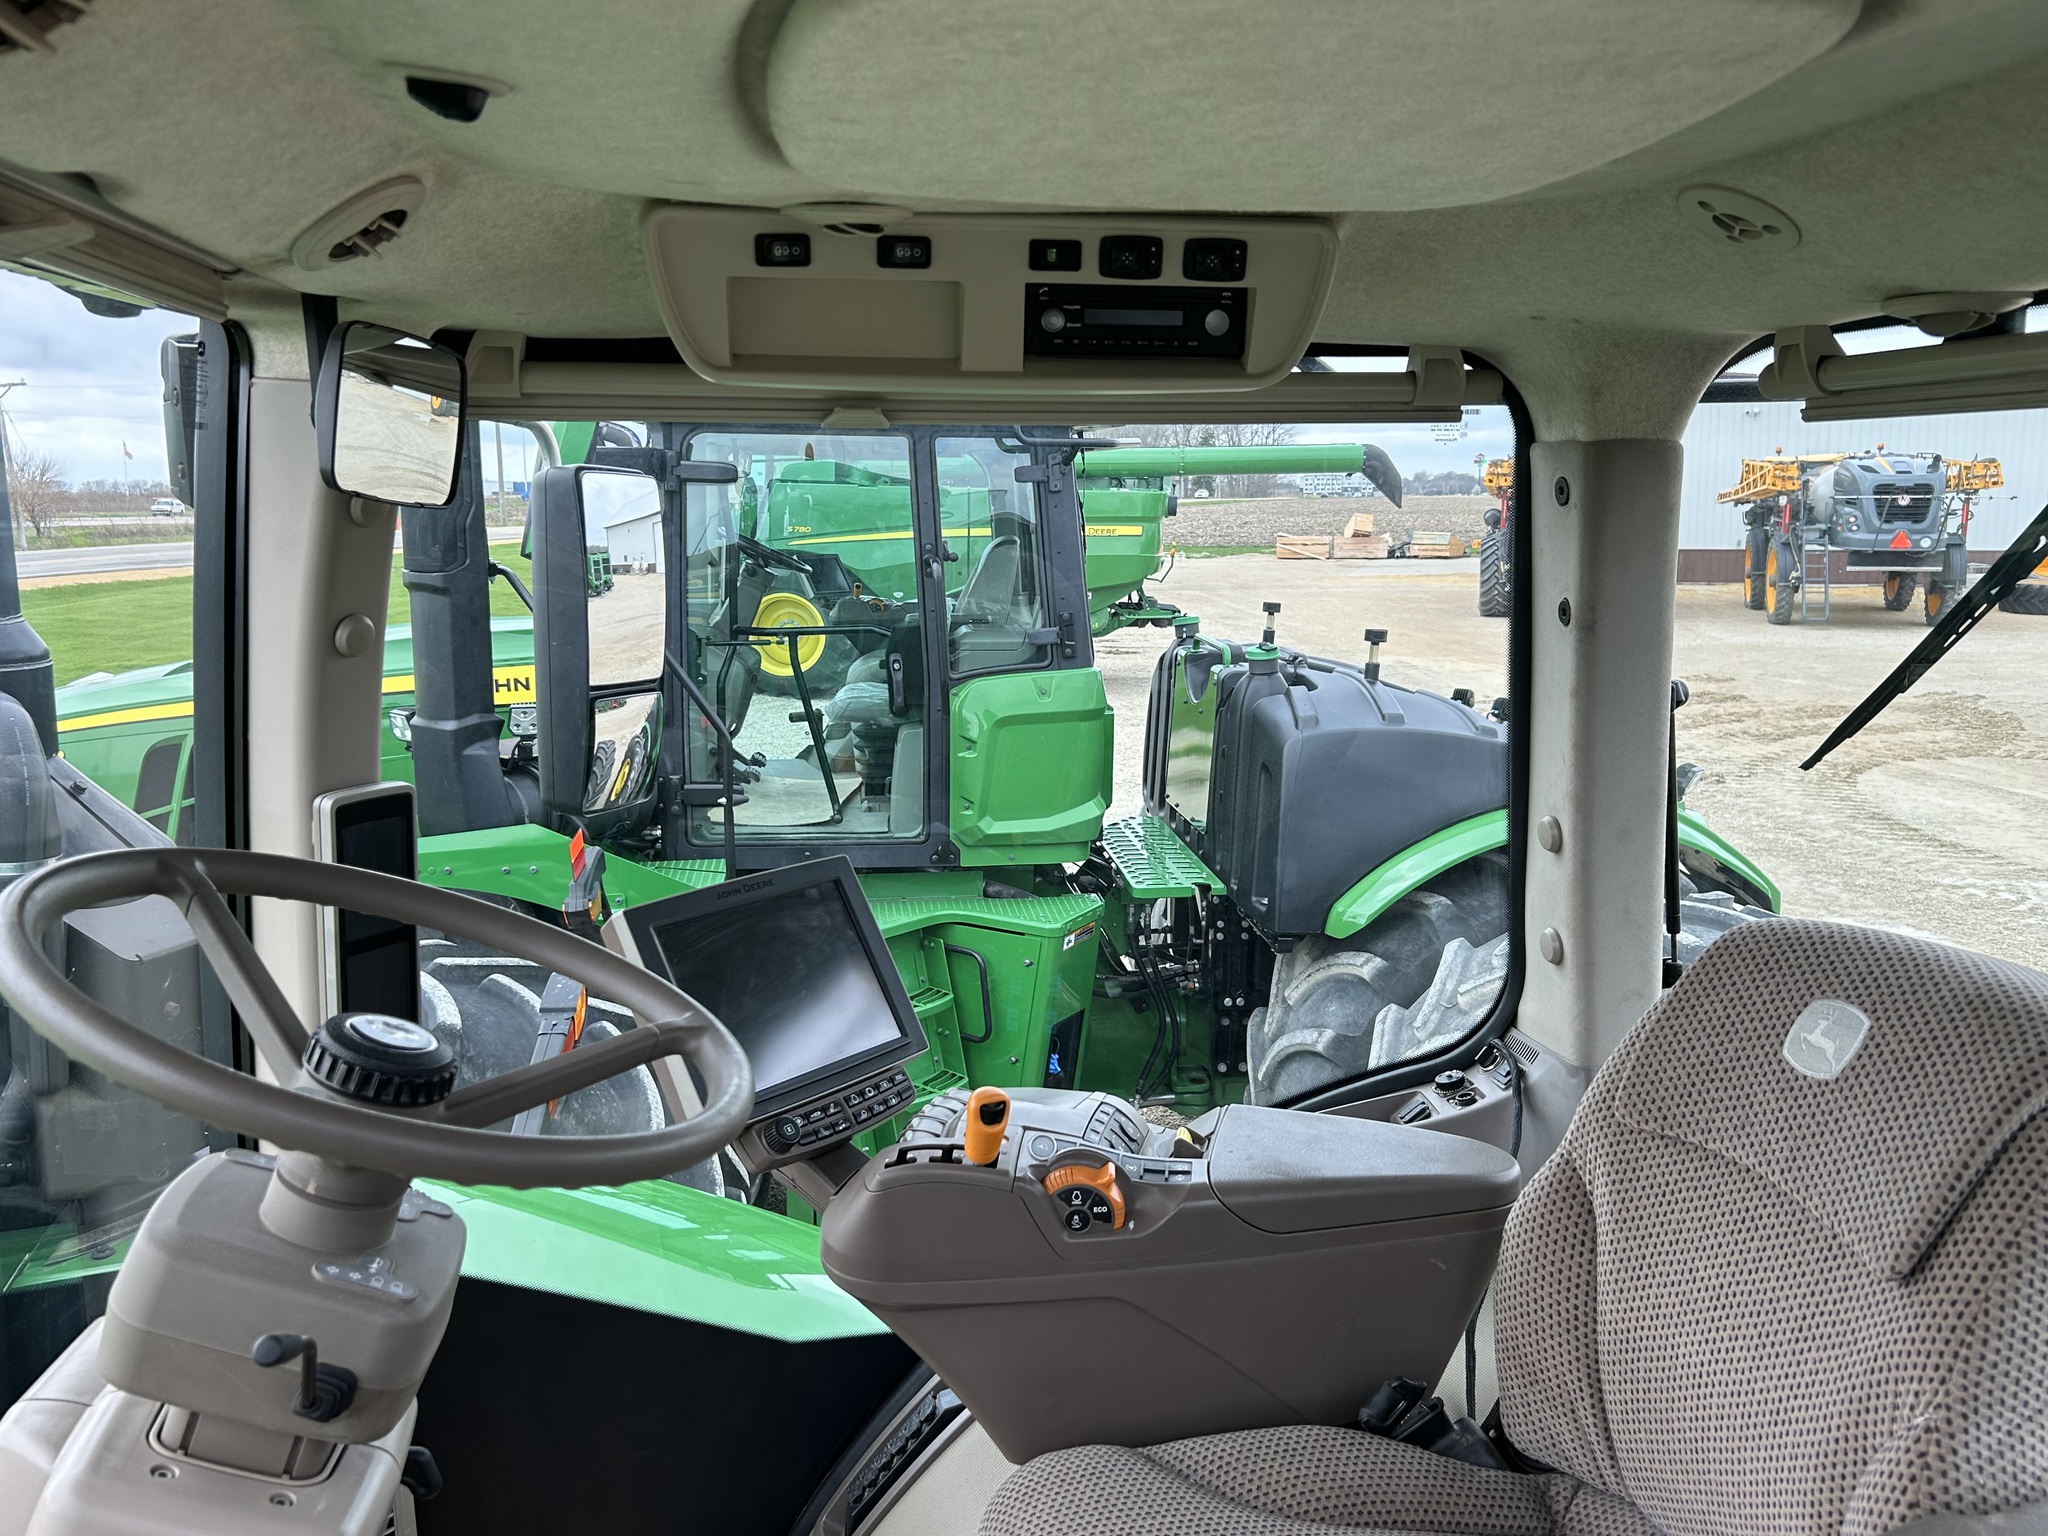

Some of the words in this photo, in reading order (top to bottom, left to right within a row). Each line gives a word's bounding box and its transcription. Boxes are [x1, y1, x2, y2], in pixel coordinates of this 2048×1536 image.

[1088, 527, 1118, 535] DEERE
[494, 676, 531, 693] HN
[716, 887, 742, 901] JOHN
[742, 878, 776, 893] DEERE
